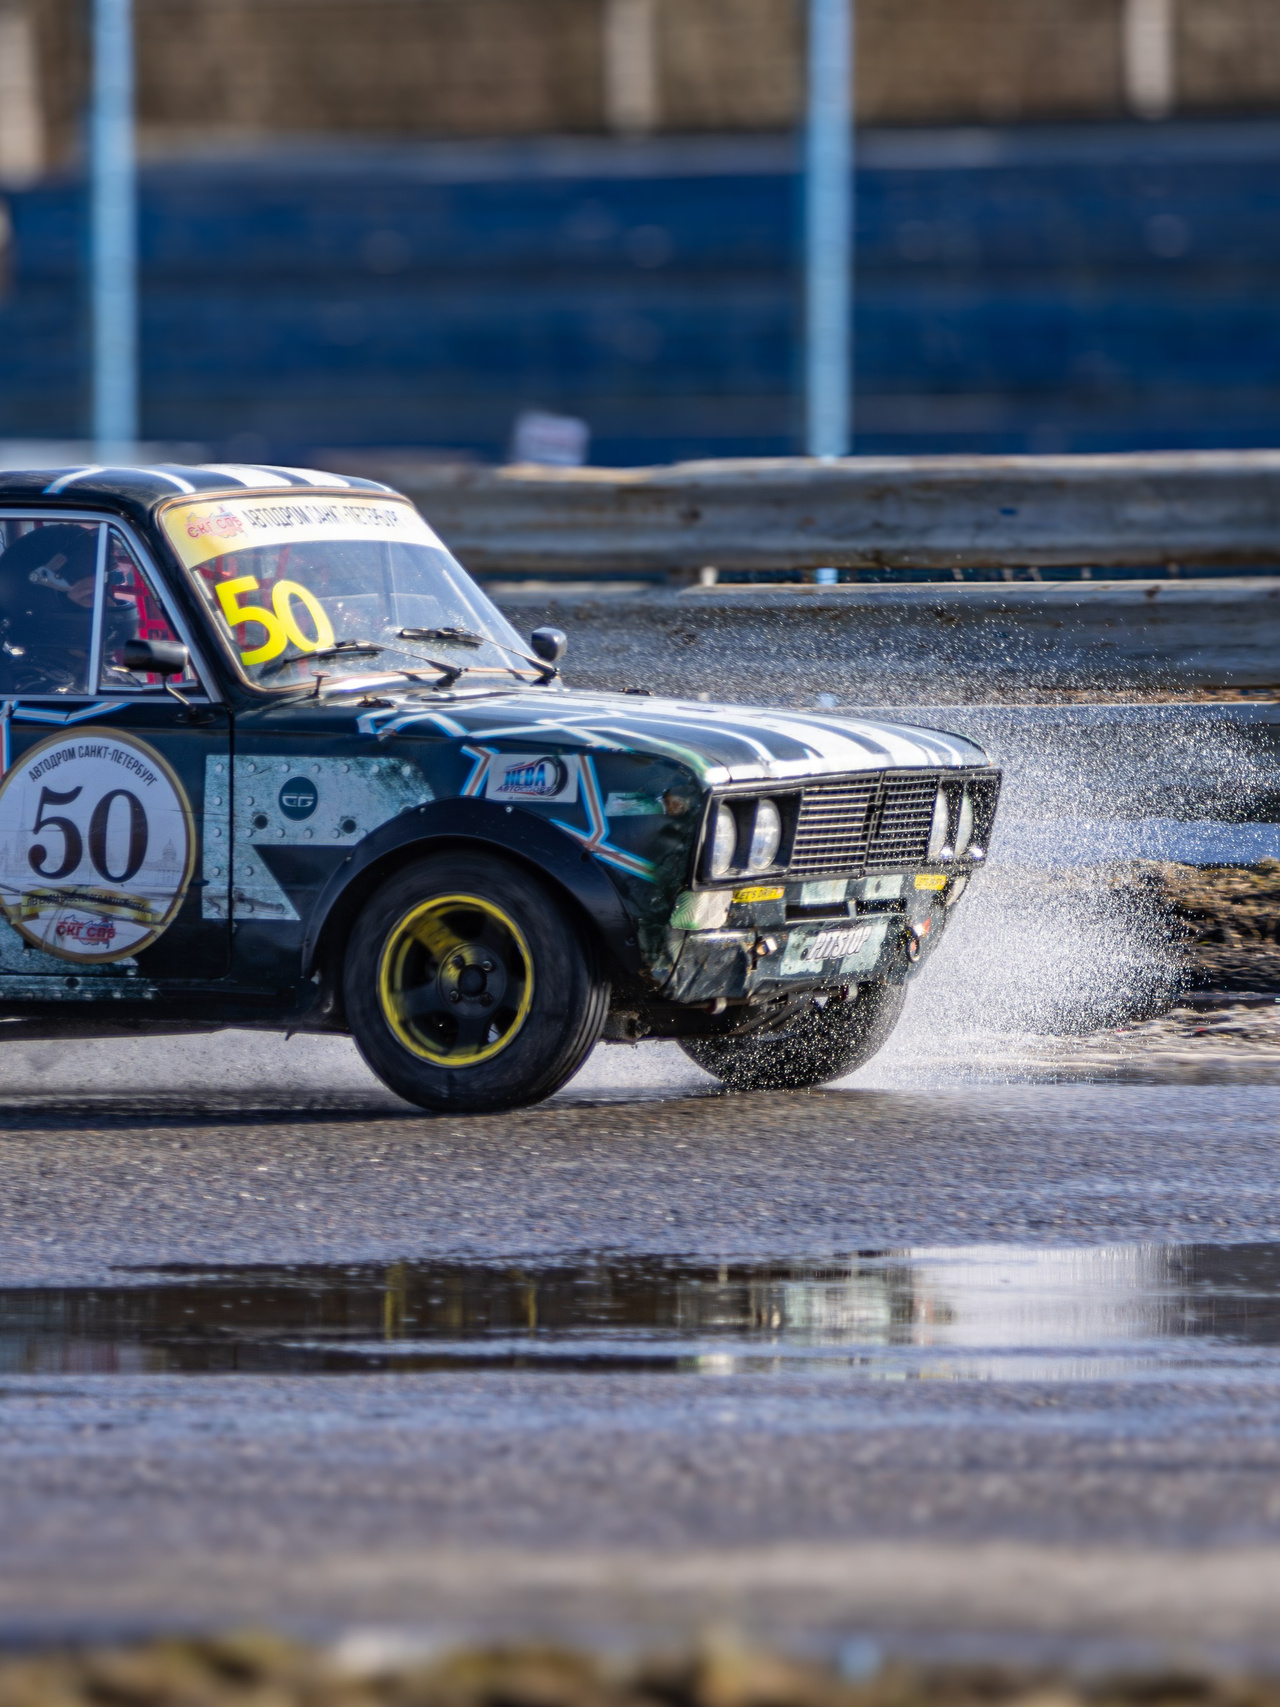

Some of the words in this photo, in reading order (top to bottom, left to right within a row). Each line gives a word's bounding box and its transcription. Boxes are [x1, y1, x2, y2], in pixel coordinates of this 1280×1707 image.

[187, 521, 213, 539] СКГ
[242, 504, 309, 529] АВТОДРОМ
[215, 575, 335, 667] 50
[28, 746, 77, 782] АВТОДРОМ
[77, 745, 158, 787] САНКТ-ПЕТЕРБУРГ
[28, 786, 149, 883] 50
[56, 924, 83, 936] СКГ
[86, 927, 116, 939] СПБ
[805, 926, 871, 962] PITSTOP
